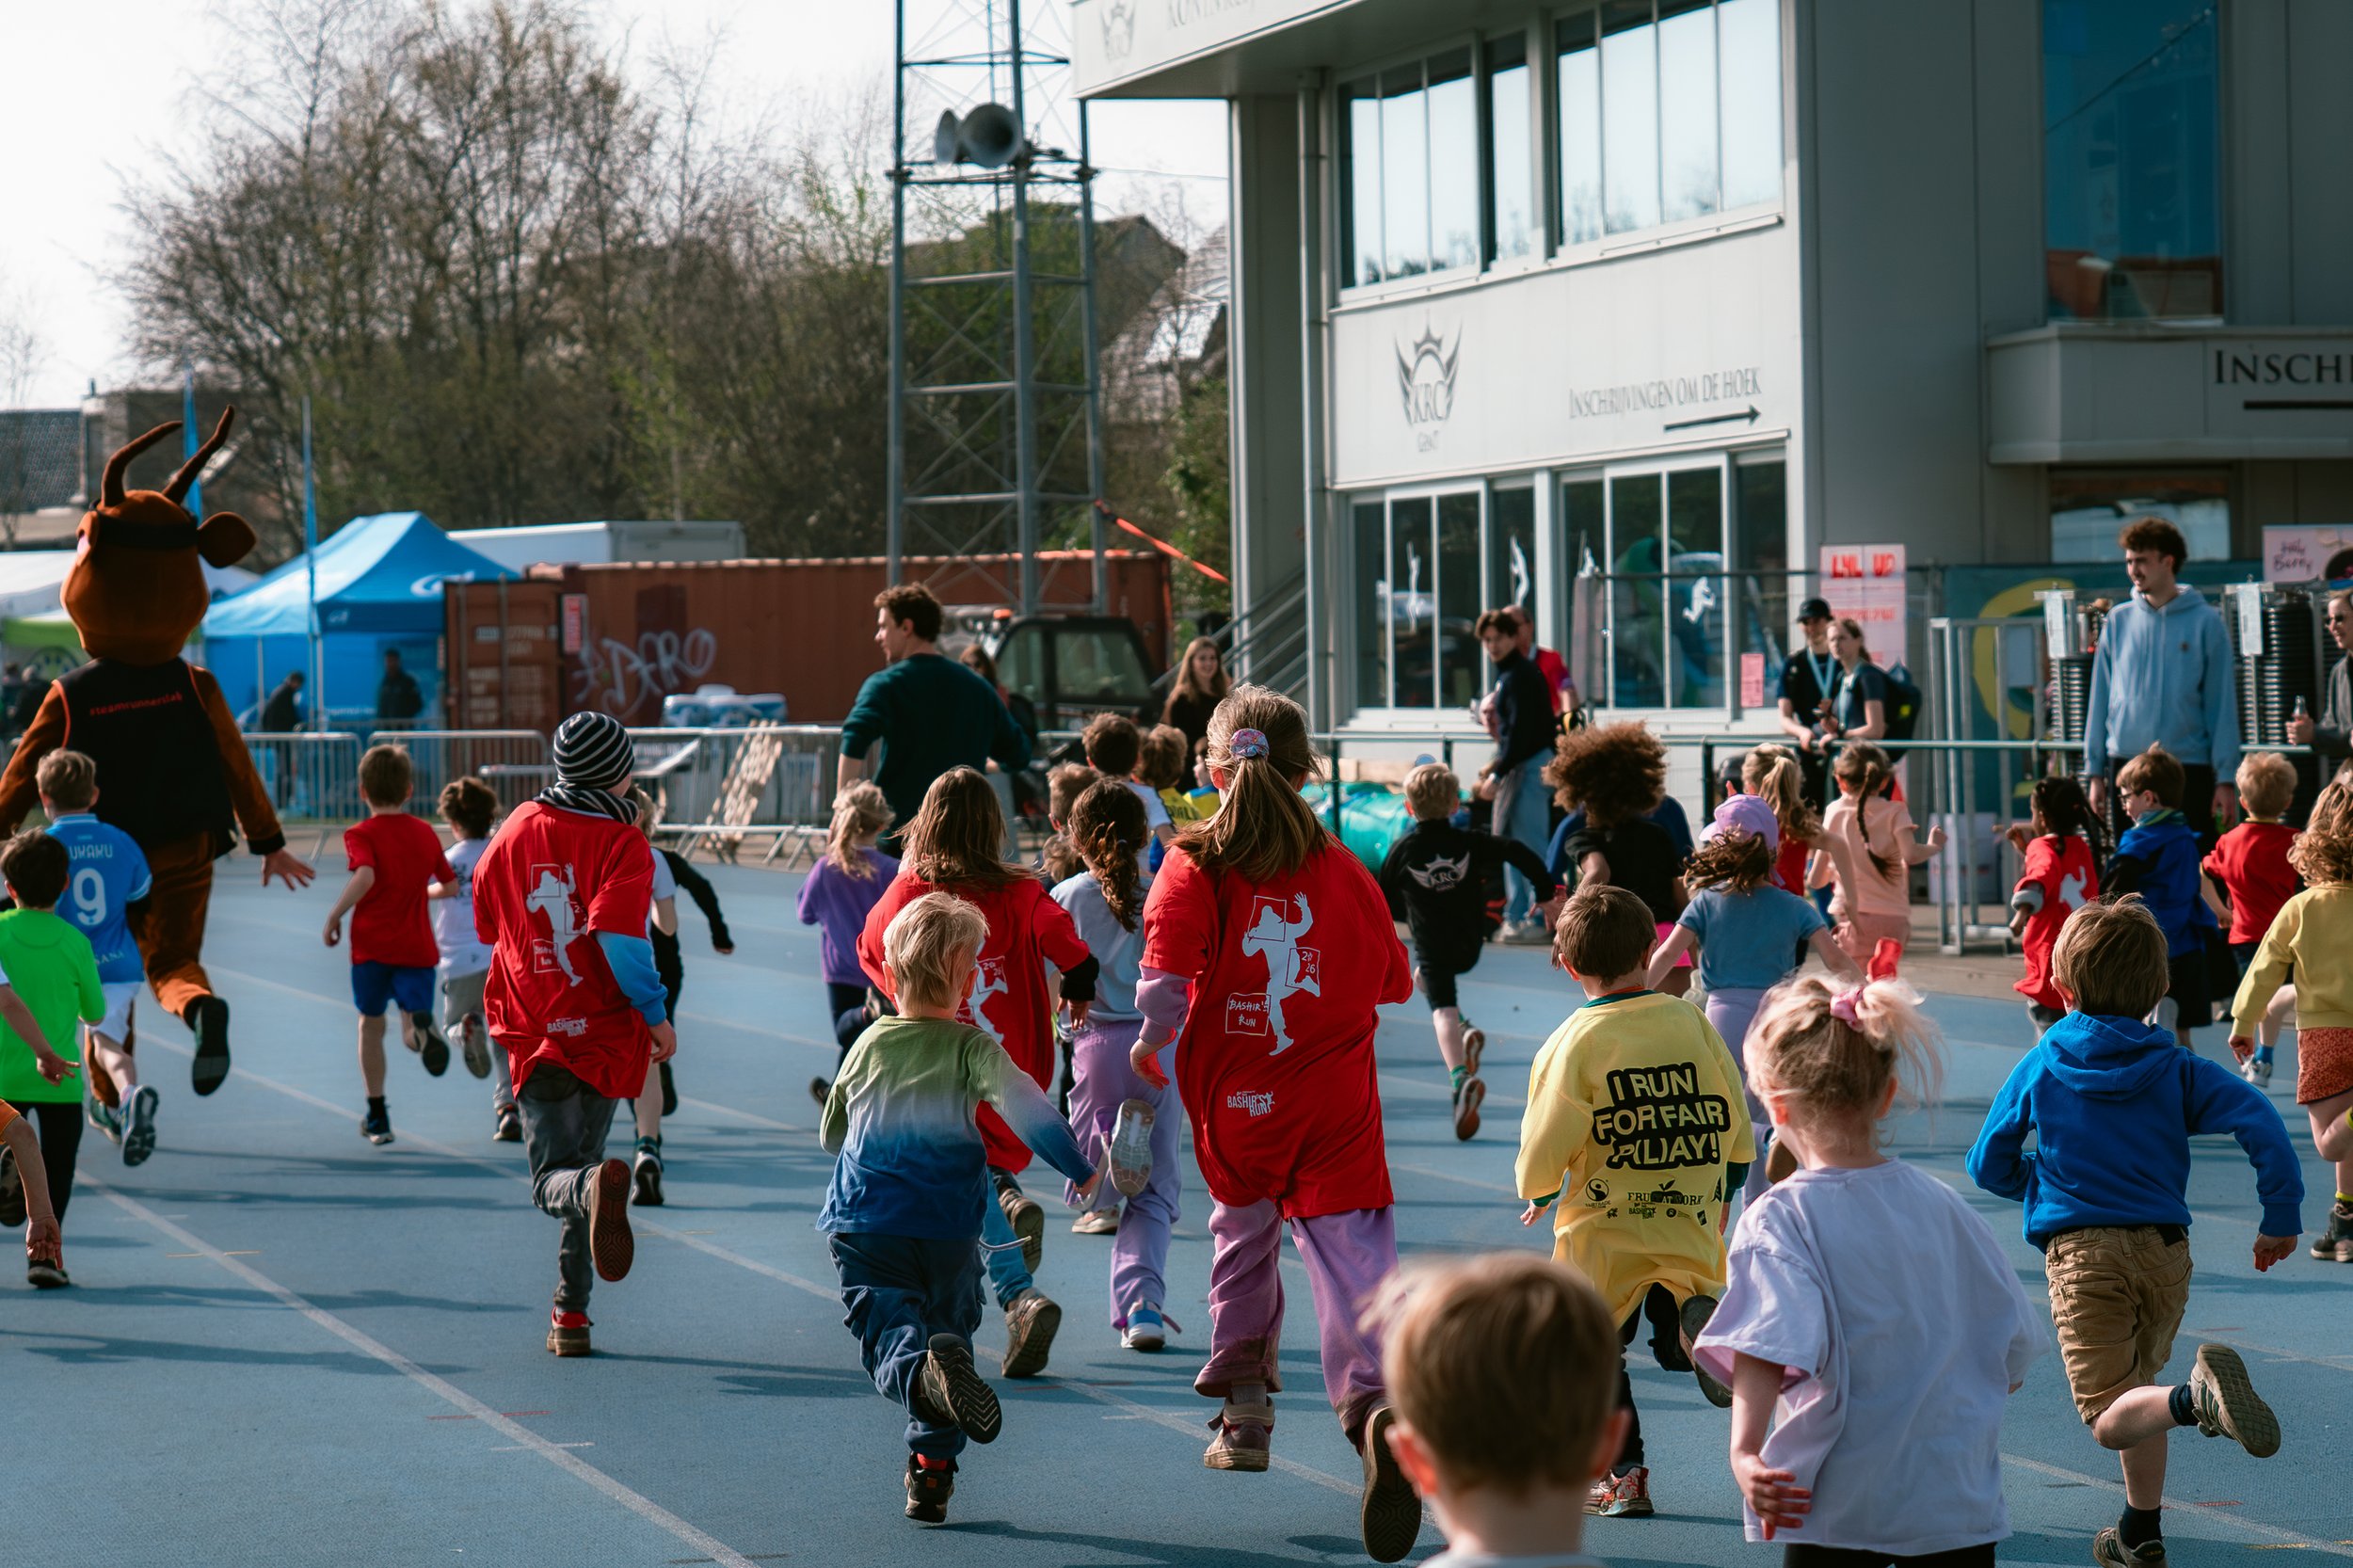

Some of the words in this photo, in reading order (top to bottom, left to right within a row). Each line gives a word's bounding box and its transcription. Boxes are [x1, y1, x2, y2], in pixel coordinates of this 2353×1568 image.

[2214, 349, 2353, 384] INSCH
[1676, 377, 1699, 407] OM
[1703, 373, 1720, 402] DE
[1722, 366, 1762, 399] HOEK
[69, 844, 113, 859] UKAKU
[72, 867, 106, 926] 9
[1228, 998, 1270, 1014] BASHIR'S
[1238, 1014, 1257, 1028] RUN
[1612, 1076, 1625, 1101] I
[1629, 1068, 1694, 1098] RUN
[1594, 1104, 1657, 1140] FOR
[1659, 1100, 1724, 1128] FAIR
[1611, 1132, 1718, 1165] P(L)AY!
[1661, 1195, 1673, 1204] AT
